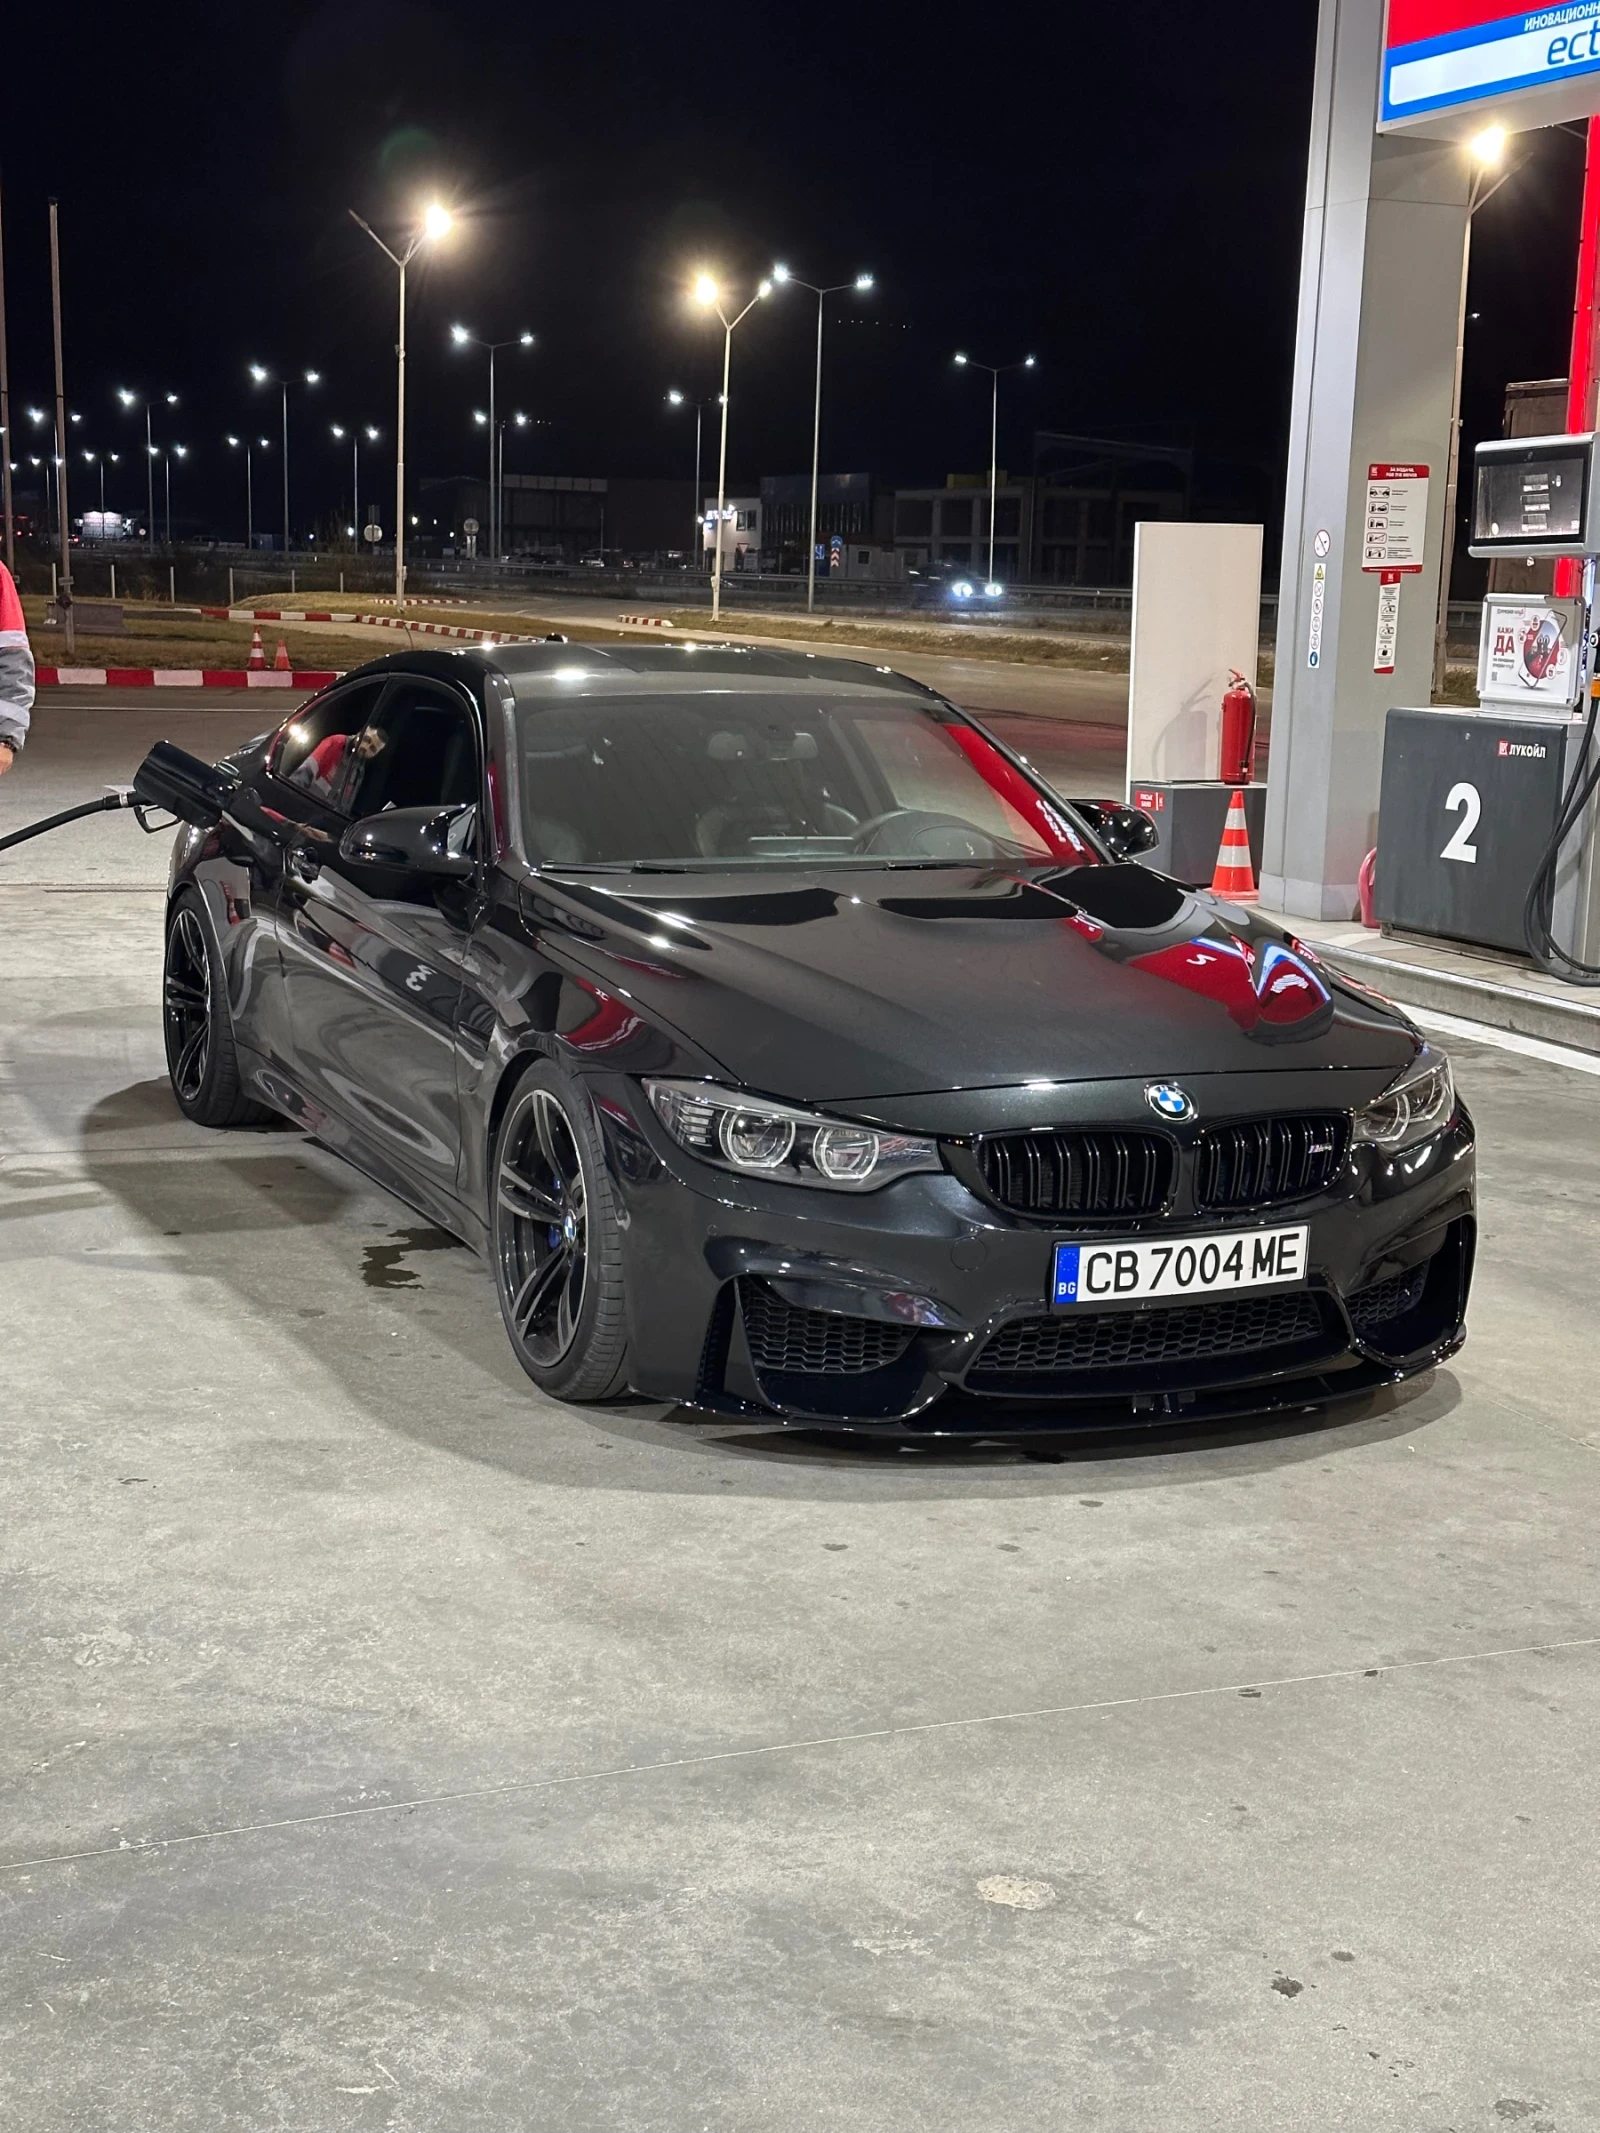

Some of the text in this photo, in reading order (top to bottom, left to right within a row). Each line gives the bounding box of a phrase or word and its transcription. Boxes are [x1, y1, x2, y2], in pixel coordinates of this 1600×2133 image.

[1494, 635, 1515, 656] ДА
[1509, 743, 1546, 759] ЛУКОЙЛ
[1440, 782, 1481, 863] 2
[1086, 1233, 1300, 1294] CB 7004 ME
[1058, 1282, 1076, 1295] BG
